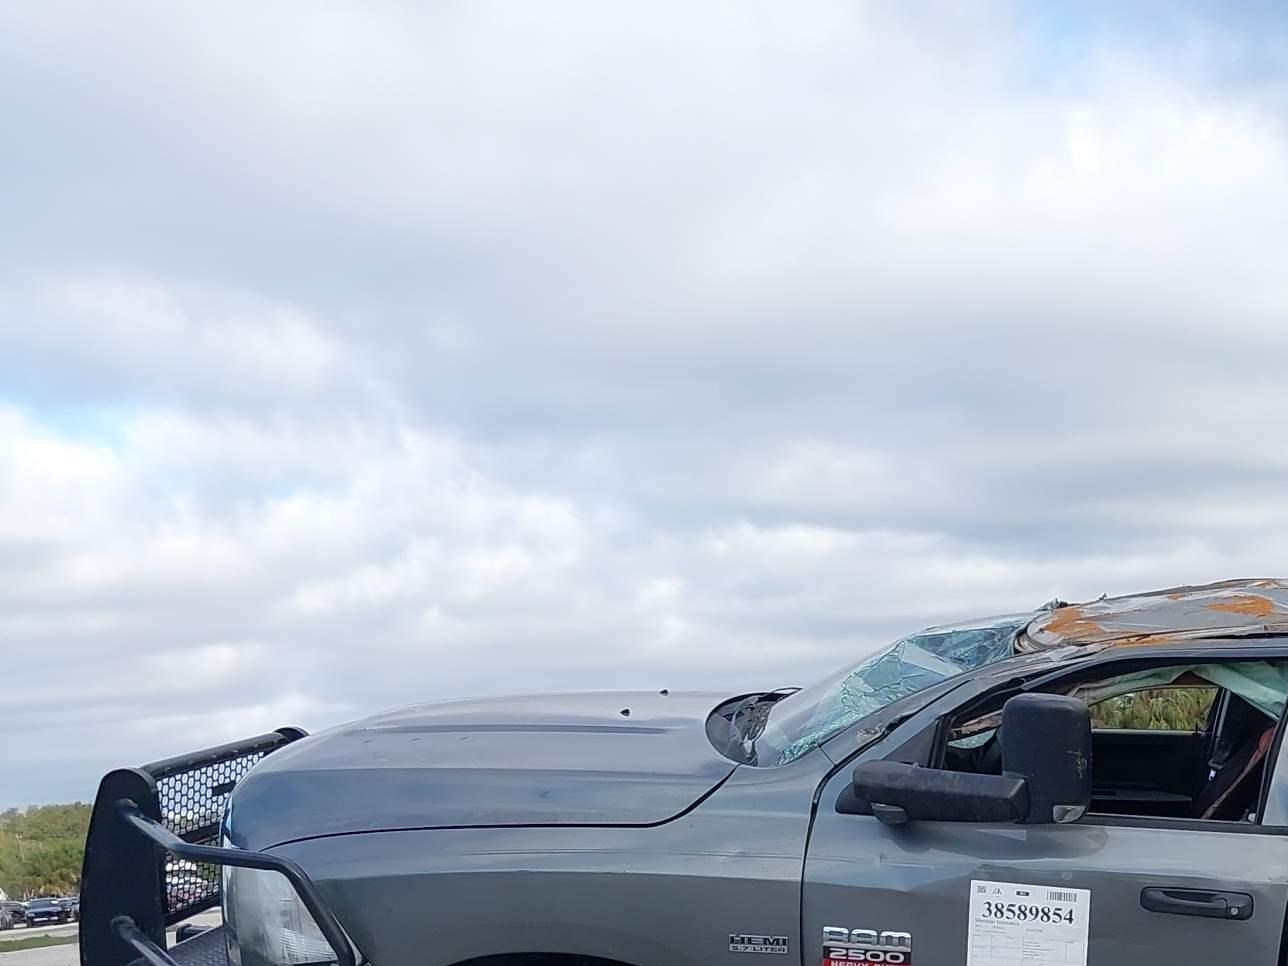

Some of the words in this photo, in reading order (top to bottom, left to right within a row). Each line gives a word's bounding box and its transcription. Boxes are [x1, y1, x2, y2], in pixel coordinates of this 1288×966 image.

[982, 901, 1074, 924] 38589854
[728, 934, 789, 946] HEMI
[752, 946, 787, 954] LITER
[829, 948, 905, 963] 2500
